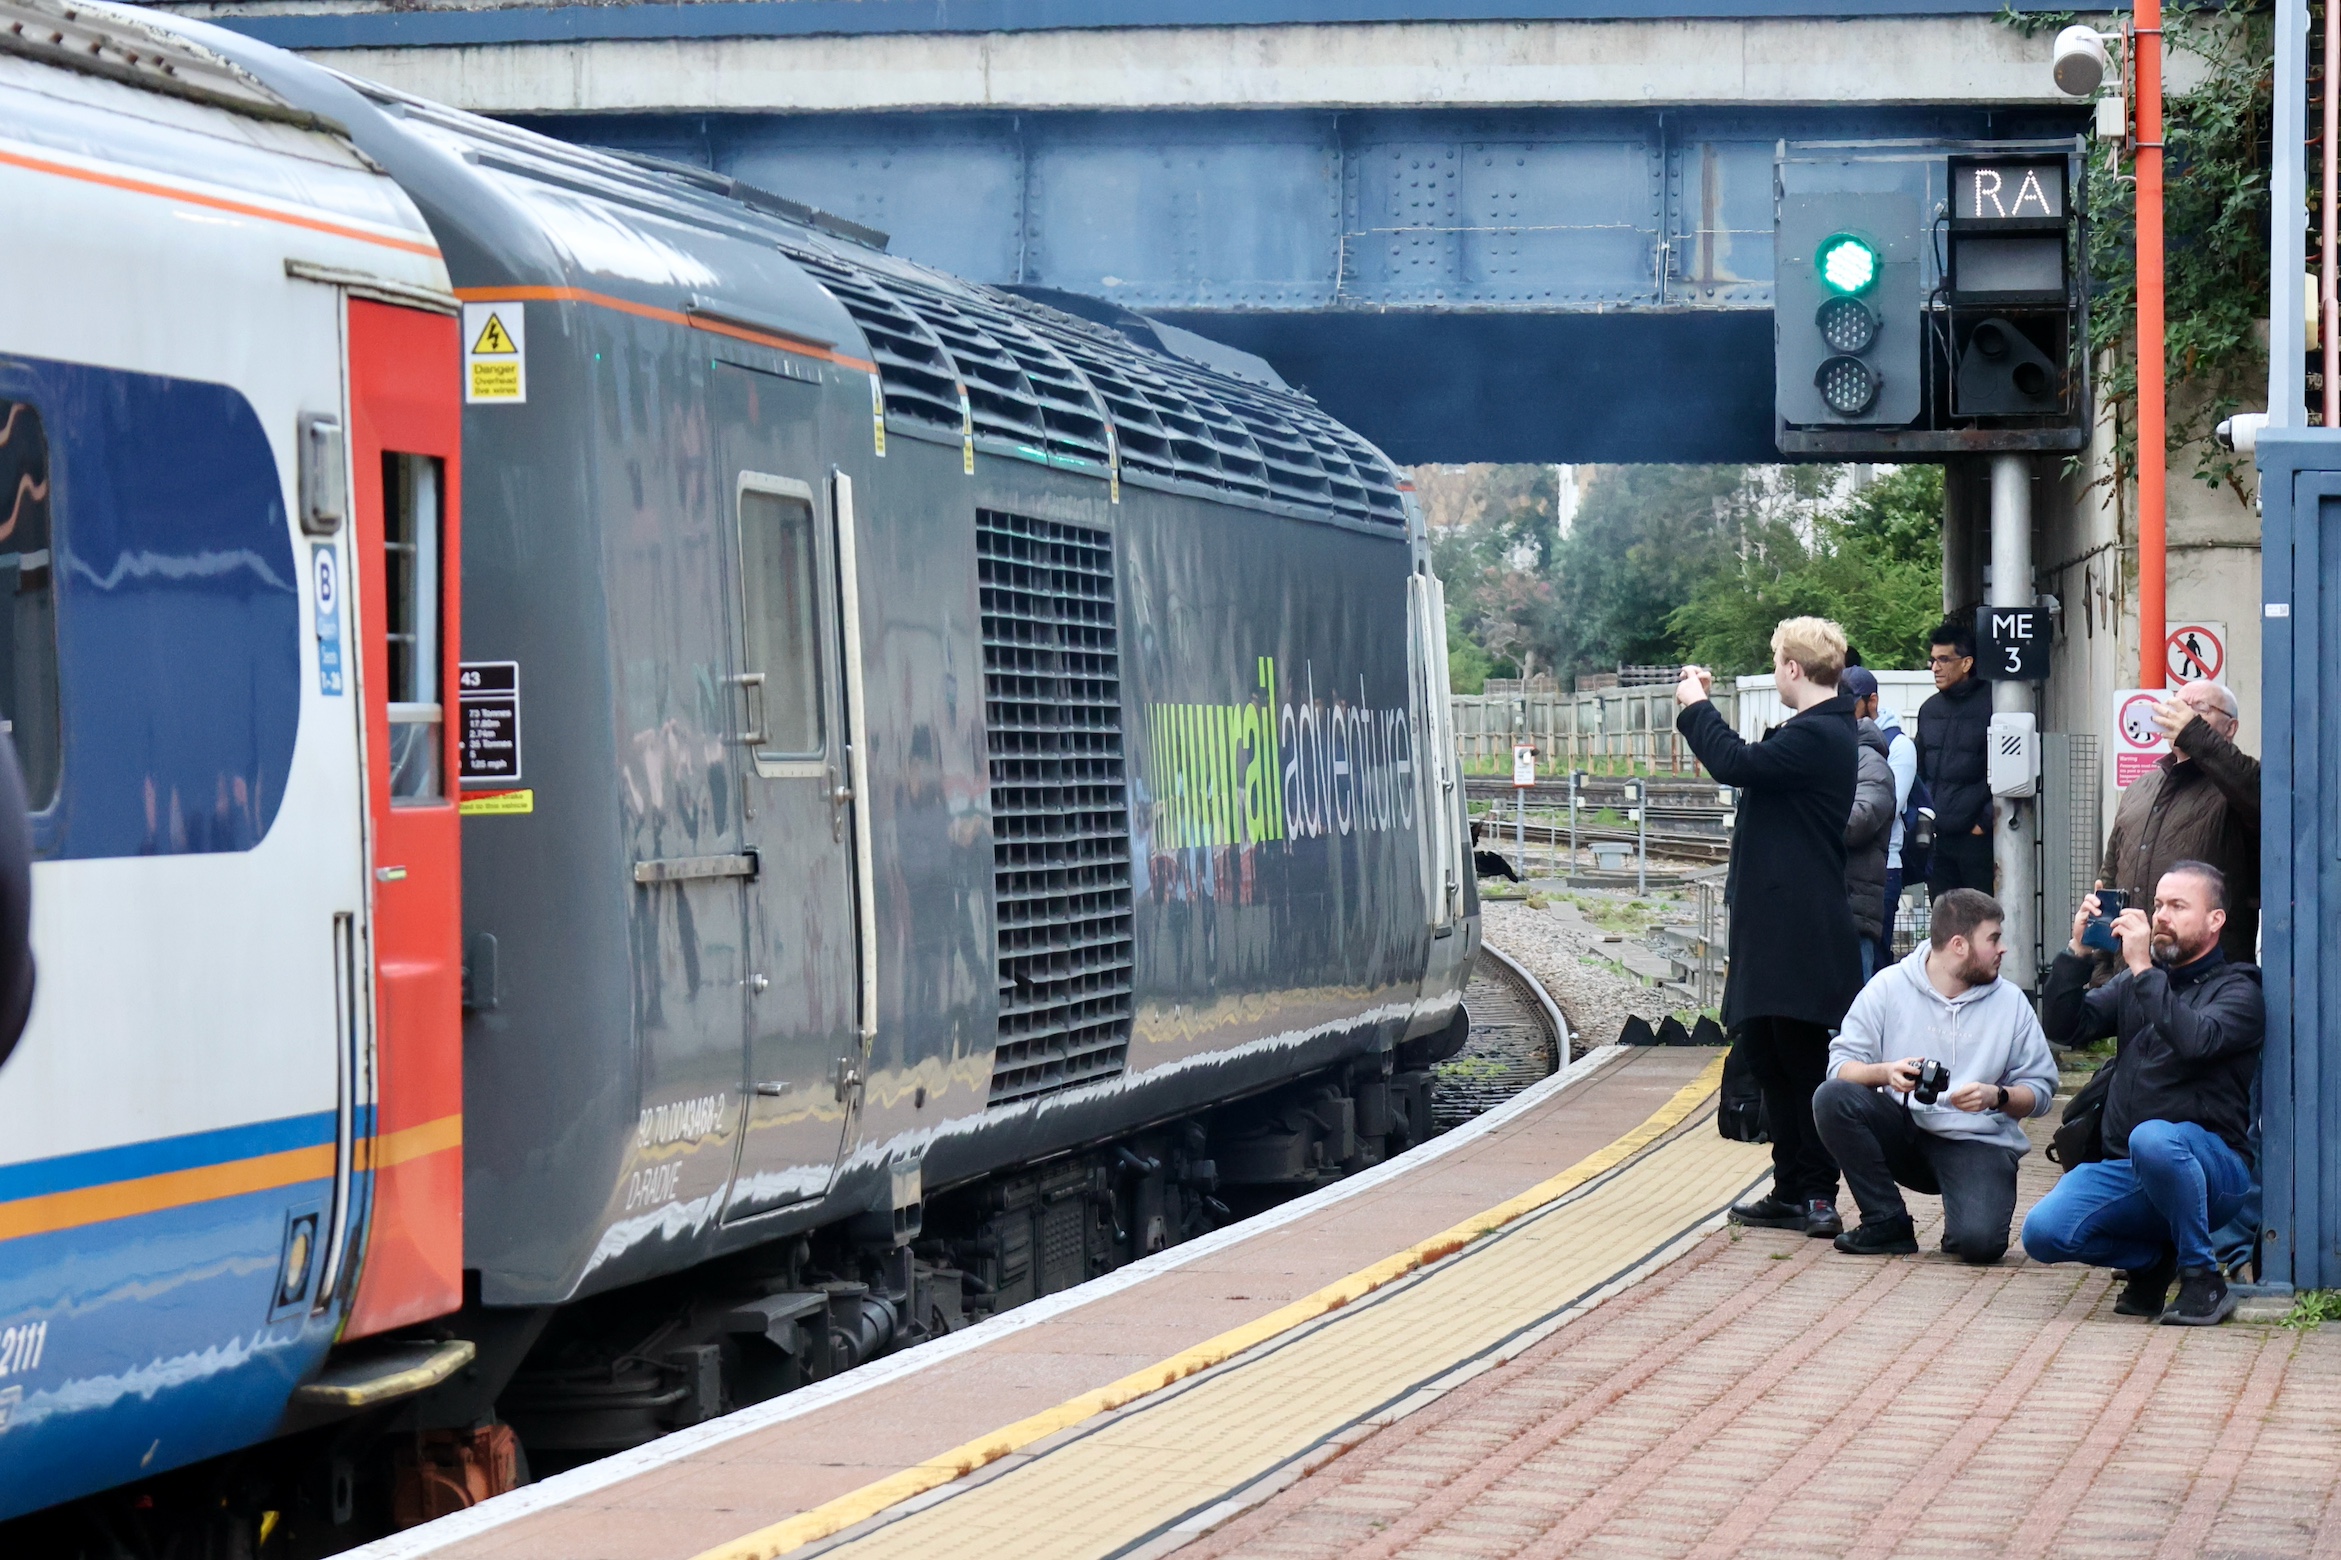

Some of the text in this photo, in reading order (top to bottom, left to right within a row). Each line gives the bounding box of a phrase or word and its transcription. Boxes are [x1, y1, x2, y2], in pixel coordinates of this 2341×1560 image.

[1975, 169, 2051, 218] RA
[474, 364, 515, 375] Danger
[320, 563, 331, 601] B
[1992, 613, 2034, 639] ME
[2004, 646, 2022, 673] 3
[461, 671, 481, 687] 43
[487, 759, 508, 770] mph
[0, 1320, 48, 1377] 2111
